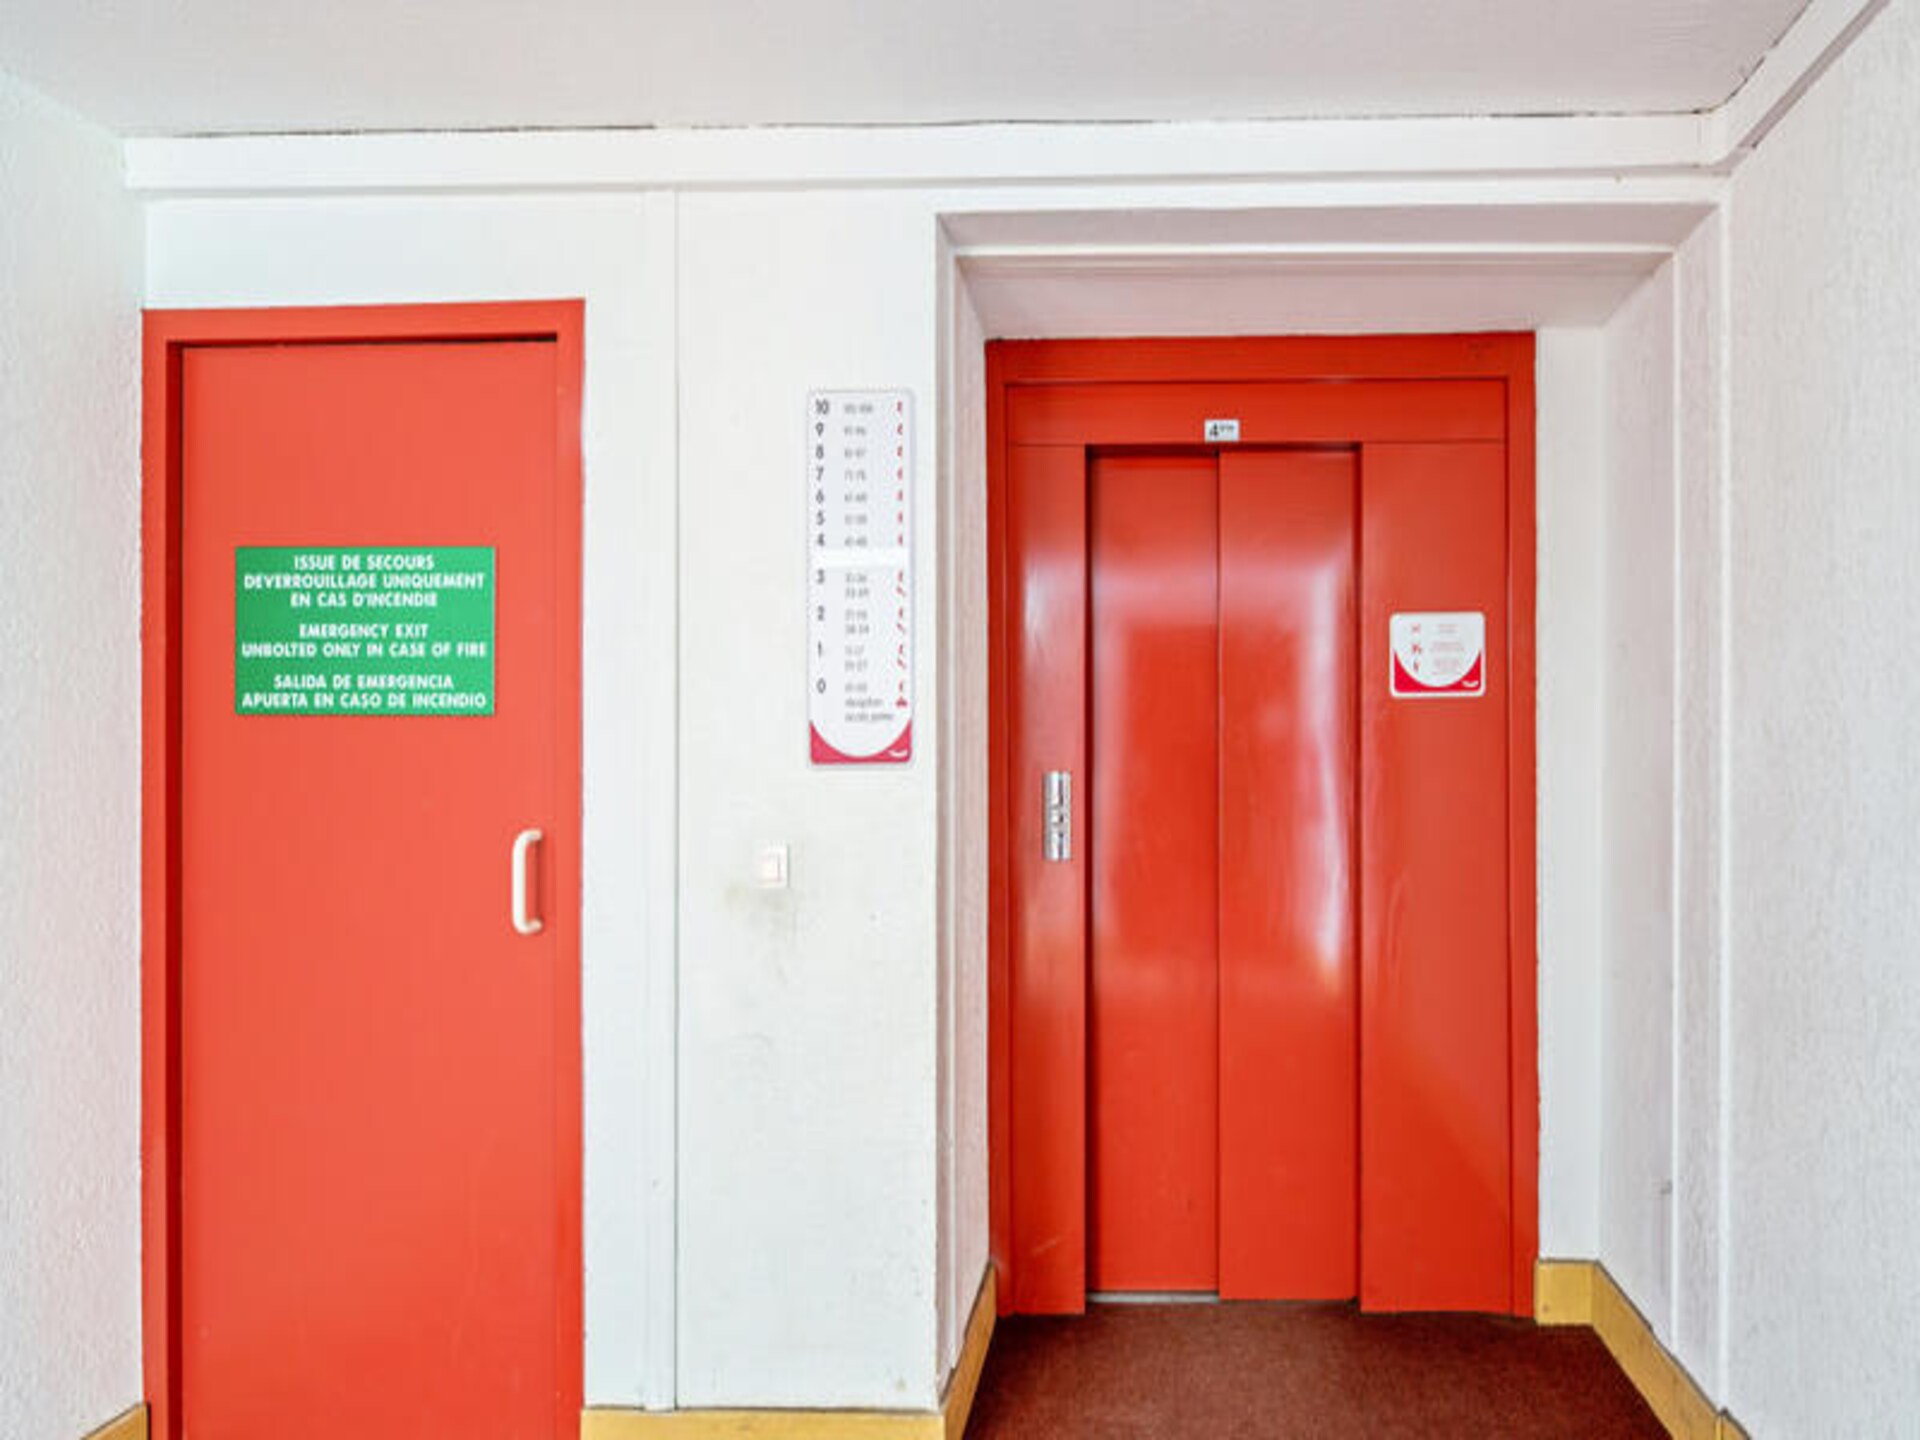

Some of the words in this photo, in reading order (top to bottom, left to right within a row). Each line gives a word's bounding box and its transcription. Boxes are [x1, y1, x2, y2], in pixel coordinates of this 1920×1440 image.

[815, 398, 829, 415] 10
[815, 421, 824, 437] 9
[815, 444, 824, 460] 8
[815, 465, 824, 481] 7
[815, 488, 824, 504] 6
[815, 510, 825, 526] 5
[816, 532, 825, 547] 4
[294, 554, 336, 571] ISSUE
[342, 554, 360, 571] DE
[367, 554, 435, 571] SECOURS
[243, 572, 377, 590] DEVERROUILLAGE
[383, 572, 485, 590] UNIQUEMENT
[817, 568, 825, 584] 3
[290, 592, 311, 608] EN
[317, 592, 347, 608] CAS
[352, 592, 438, 608] D'INCENDIE
[817, 604, 825, 621] 2
[299, 624, 389, 639] EMERGENCY
[395, 624, 429, 639] EXIT
[242, 642, 317, 658] UNBOLTED
[322, 642, 361, 658] ONLY
[366, 642, 383, 658] IN
[388, 642, 425, 658] CASE
[431, 642, 450, 658] OF
[456, 642, 486, 658] FIRE
[273, 674, 327, 690] SALIDA
[333, 674, 351, 690] DE
[357, 674, 454, 690] EMERGENCIA
[816, 677, 826, 694] 0
[242, 693, 308, 709] APUERTA
[314, 693, 334, 709] EN
[340, 693, 382, 709] CASO
[387, 693, 406, 709] DE
[412, 693, 486, 709] INCENDIO
